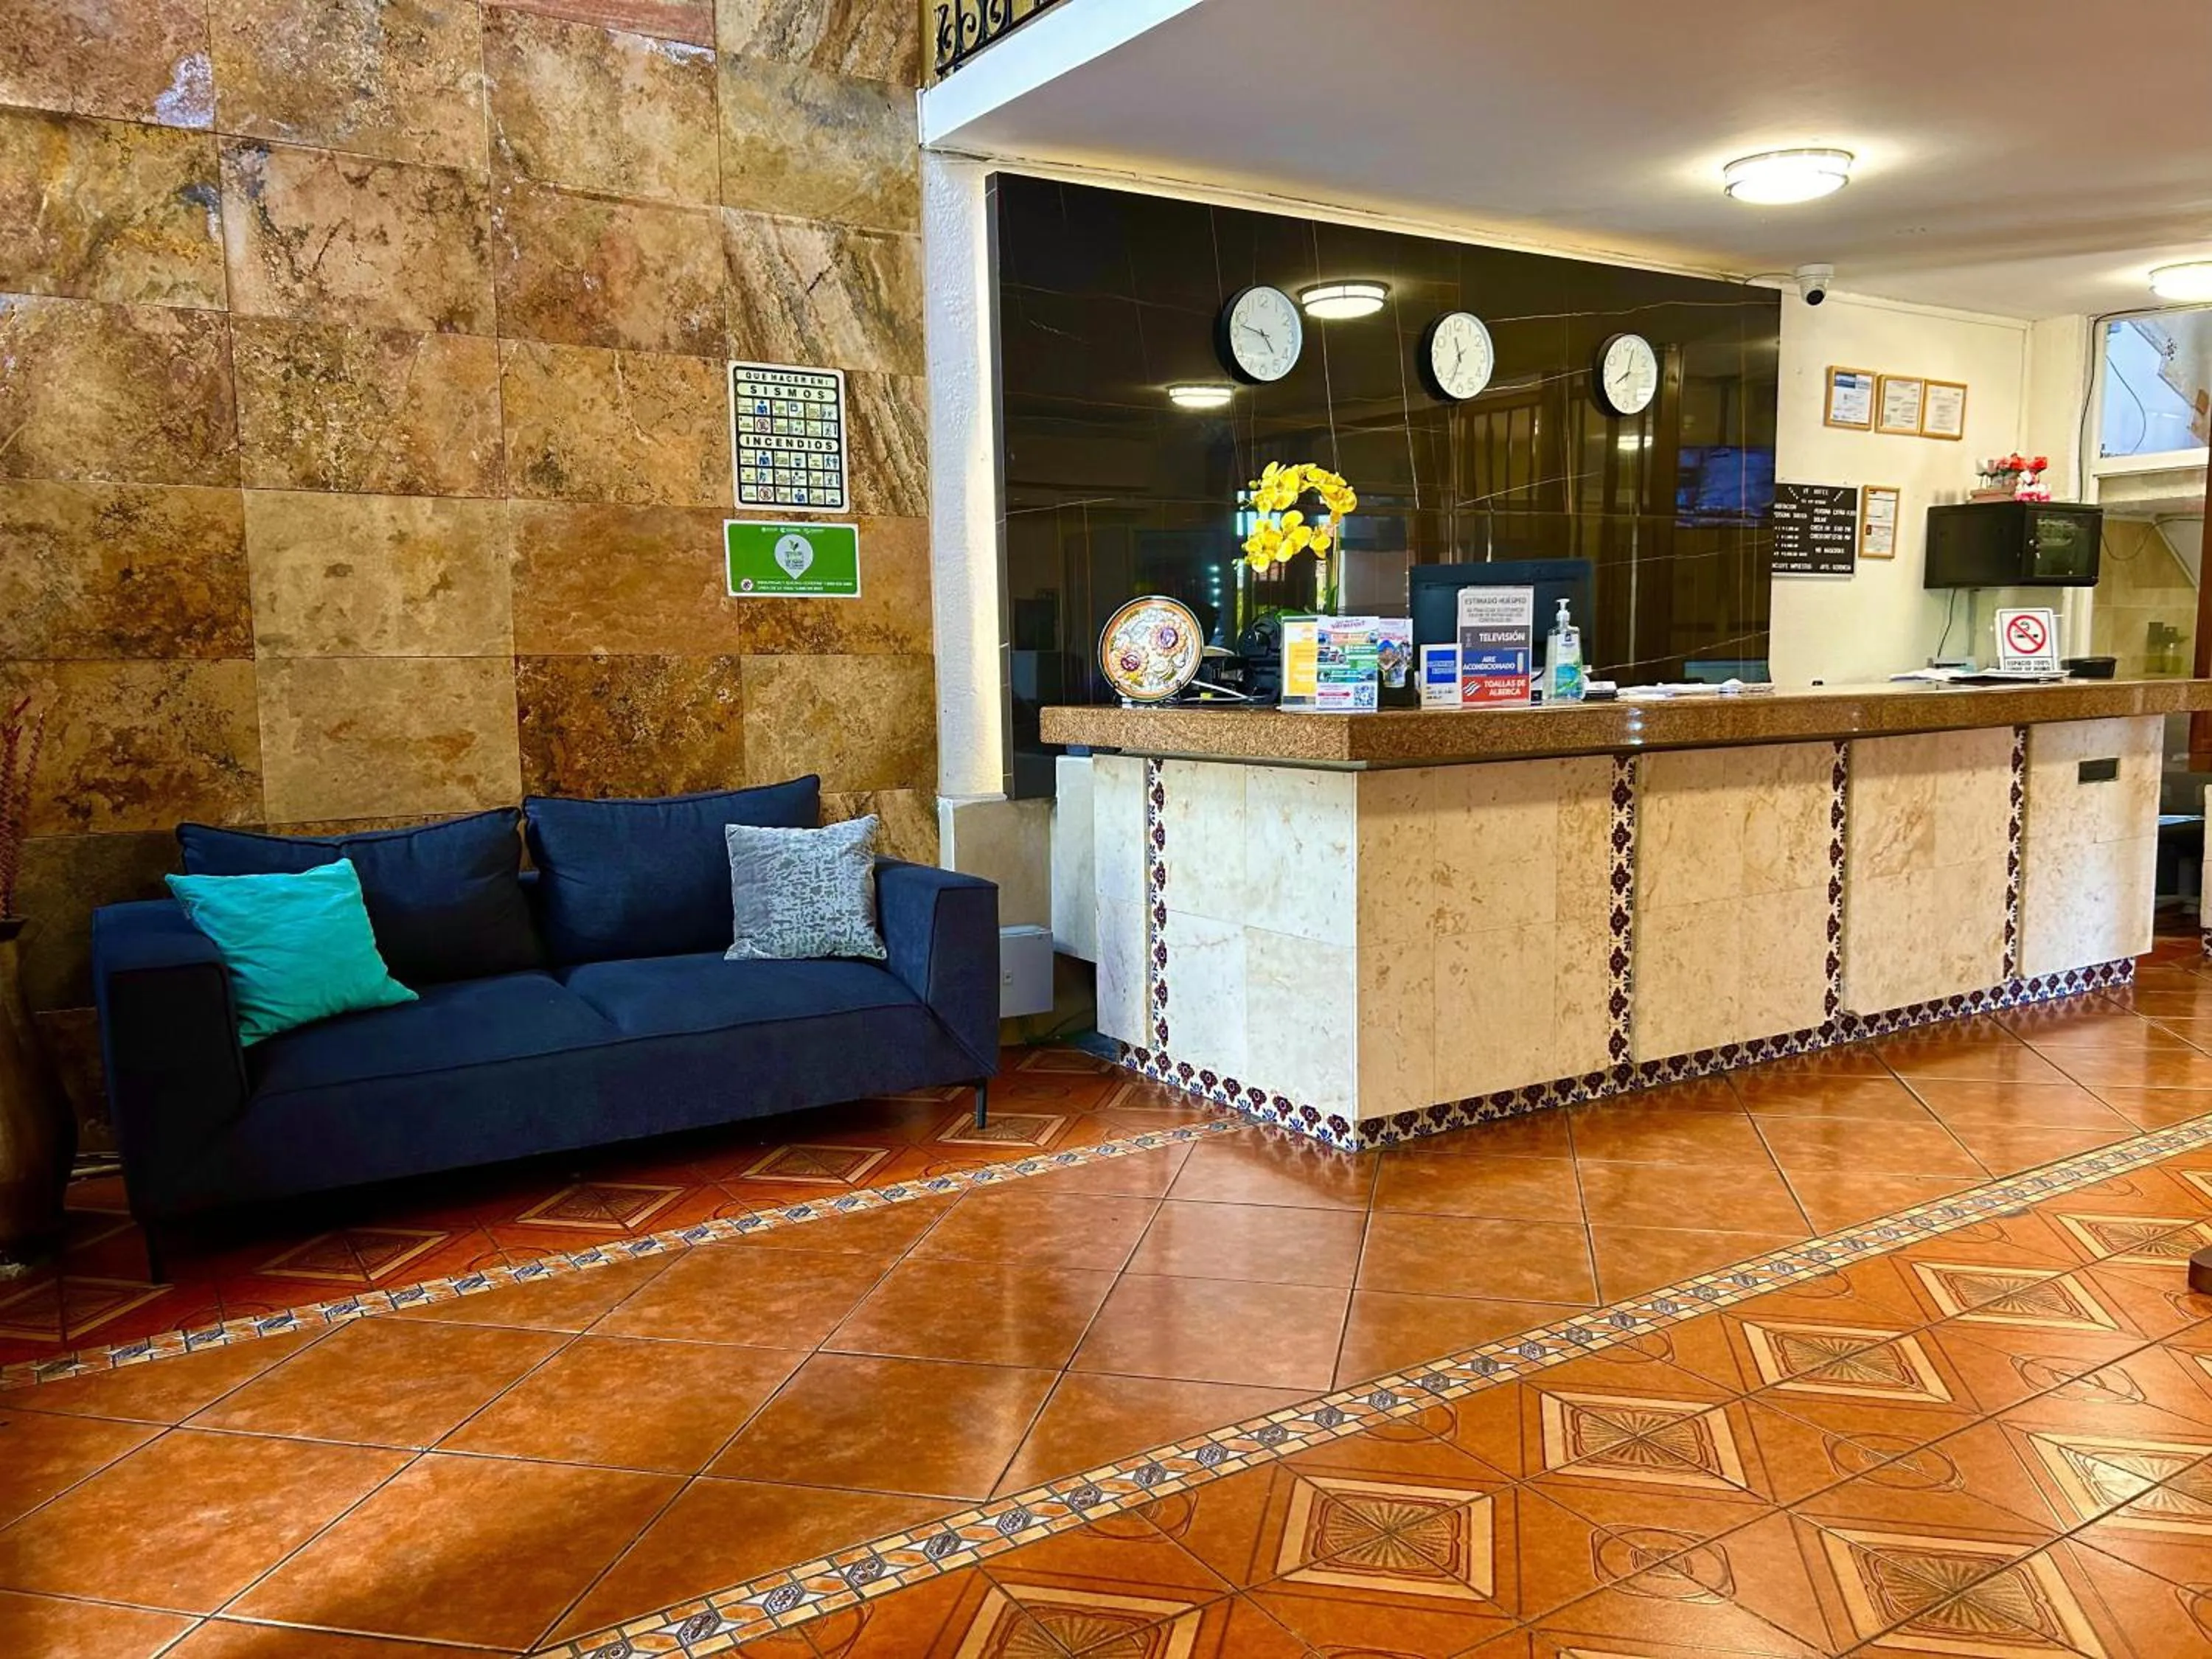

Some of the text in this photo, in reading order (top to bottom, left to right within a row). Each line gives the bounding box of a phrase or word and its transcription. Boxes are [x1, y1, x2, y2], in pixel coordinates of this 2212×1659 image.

[746, 372, 767, 381] QUE
[771, 374, 807, 383] HACER
[750, 385, 825, 400] SISMOS
[745, 437, 832, 451] INCENDIOS
[1478, 629, 1526, 642] TELEVISIÓN
[1484, 679, 1526, 688] TOALLAS DE
[1489, 687, 1522, 697] ALBERCA
